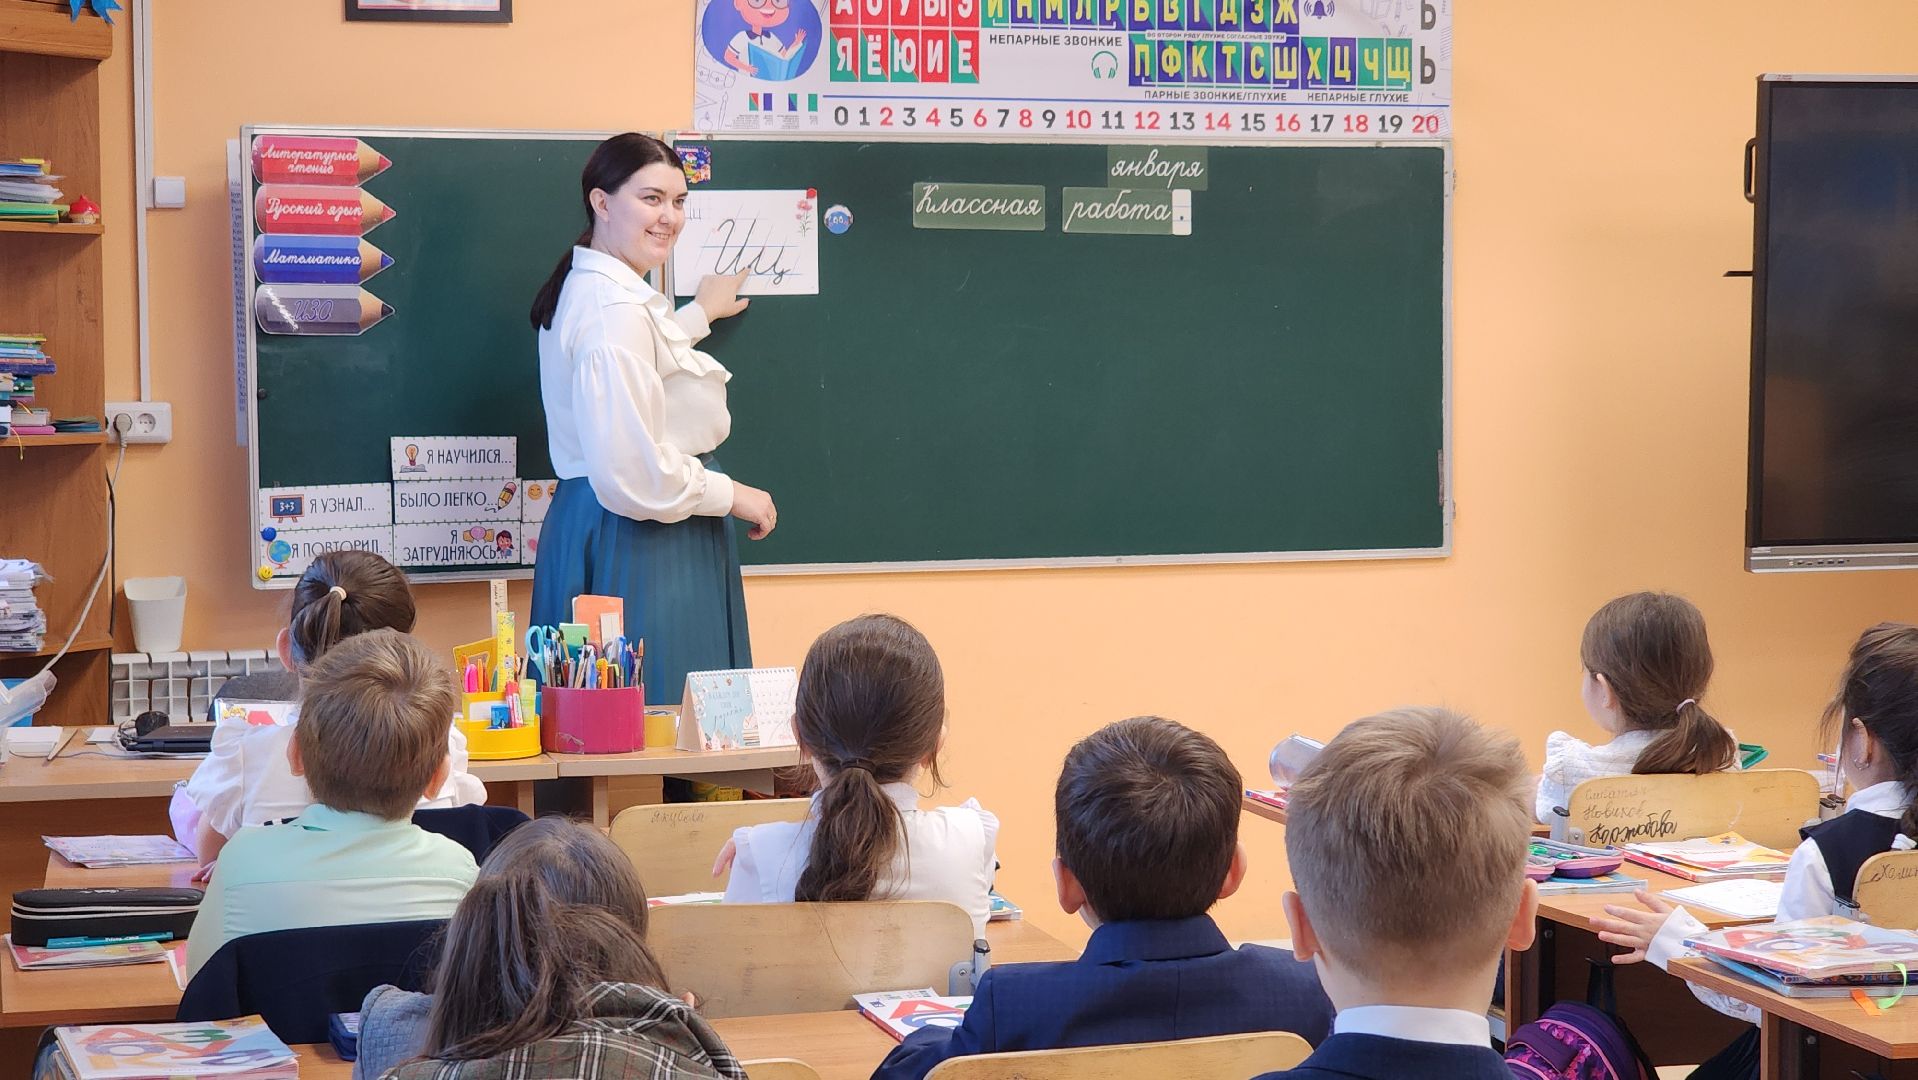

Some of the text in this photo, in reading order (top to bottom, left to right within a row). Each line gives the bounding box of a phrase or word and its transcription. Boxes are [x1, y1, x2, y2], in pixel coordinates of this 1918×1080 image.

[989, 34, 1123, 47] НЕПАРНЫЕ ЗВОНКИЕ
[836, 34, 973, 75] Я Ё Ю И Е
[1134, 44, 1298, 80] П Ф К Т С Ш
[1306, 45, 1411, 83] Х Ц Ч Щ
[1144, 90, 1287, 102] ПАРНЫЕ ЗВОНКИЕ/ГЛУХИЕ
[1307, 92, 1409, 103] НЕПАРНЫЕ ГЛУХИЕ
[859, 107, 870, 126] 1
[880, 106, 893, 127] 2
[902, 107, 916, 127] 3
[925, 107, 941, 127] 4
[950, 107, 964, 127] 5
[973, 108, 987, 128] 6
[997, 108, 1010, 128] 7
[1019, 108, 1033, 128] 8
[1042, 108, 1056, 129] 9
[1066, 109, 1092, 129] 10
[1101, 110, 1125, 130] 11
[1135, 110, 1160, 130] 12
[1170, 110, 1195, 130] 13
[1204, 111, 1232, 131] 14
[1241, 111, 1266, 131] 15
[1275, 112, 1301, 132] 16
[1310, 112, 1335, 133] 17
[1343, 113, 1369, 132] 18
[1378, 114, 1403, 133] 19
[1412, 114, 1439, 134] 20
[260, 144, 359, 165] Литературное
[287, 163, 334, 174] чтение
[1110, 148, 1205, 189] января
[915, 184, 1042, 217] Классная
[265, 198, 363, 222] Русский язык
[262, 248, 362, 266] Математика
[293, 299, 334, 322] ИЗО
[426, 449, 437, 465] Я
[309, 499, 318, 514] Я
[400, 492, 440, 508] БЫЛО
[451, 529, 458, 545] Я
[291, 543, 299, 559] Я
